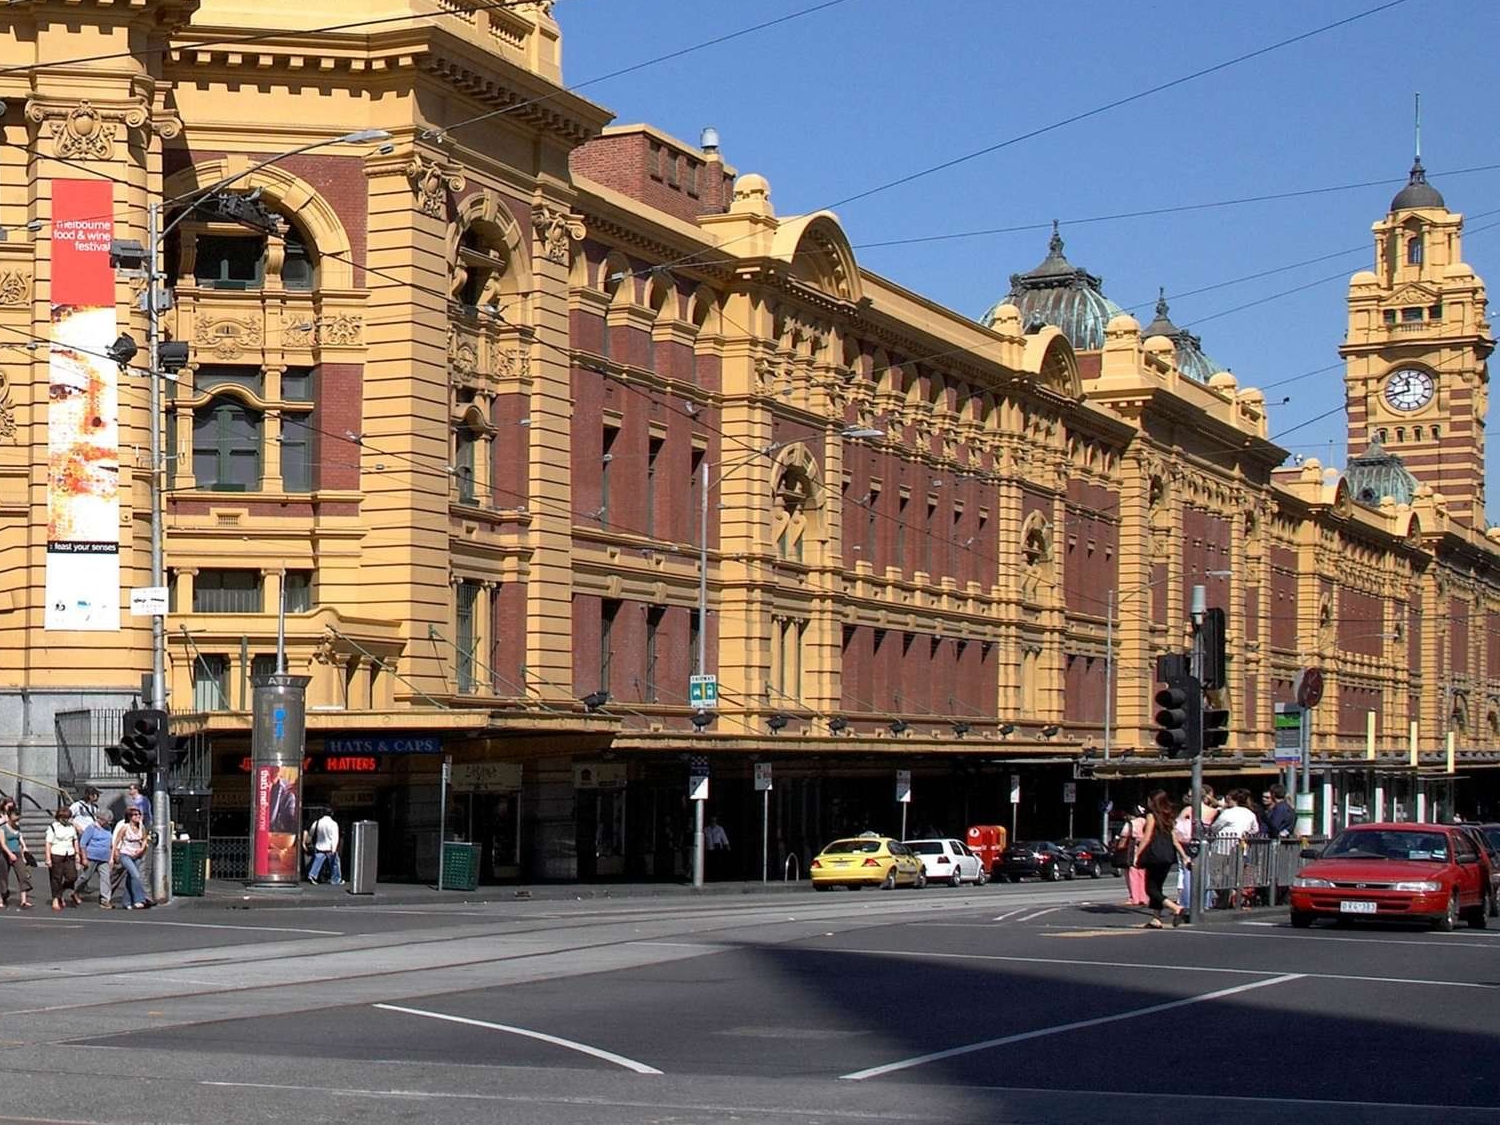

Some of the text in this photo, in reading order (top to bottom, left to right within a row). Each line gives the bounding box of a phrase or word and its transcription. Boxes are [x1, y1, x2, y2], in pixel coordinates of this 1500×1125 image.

[56, 220, 111, 230] melbourne
[53, 230, 111, 241] food & wine
[74, 241, 111, 252] festival
[74, 544, 90, 552] your
[91, 544, 116, 552] senses
[330, 739, 434, 753] HATS & CAPS
